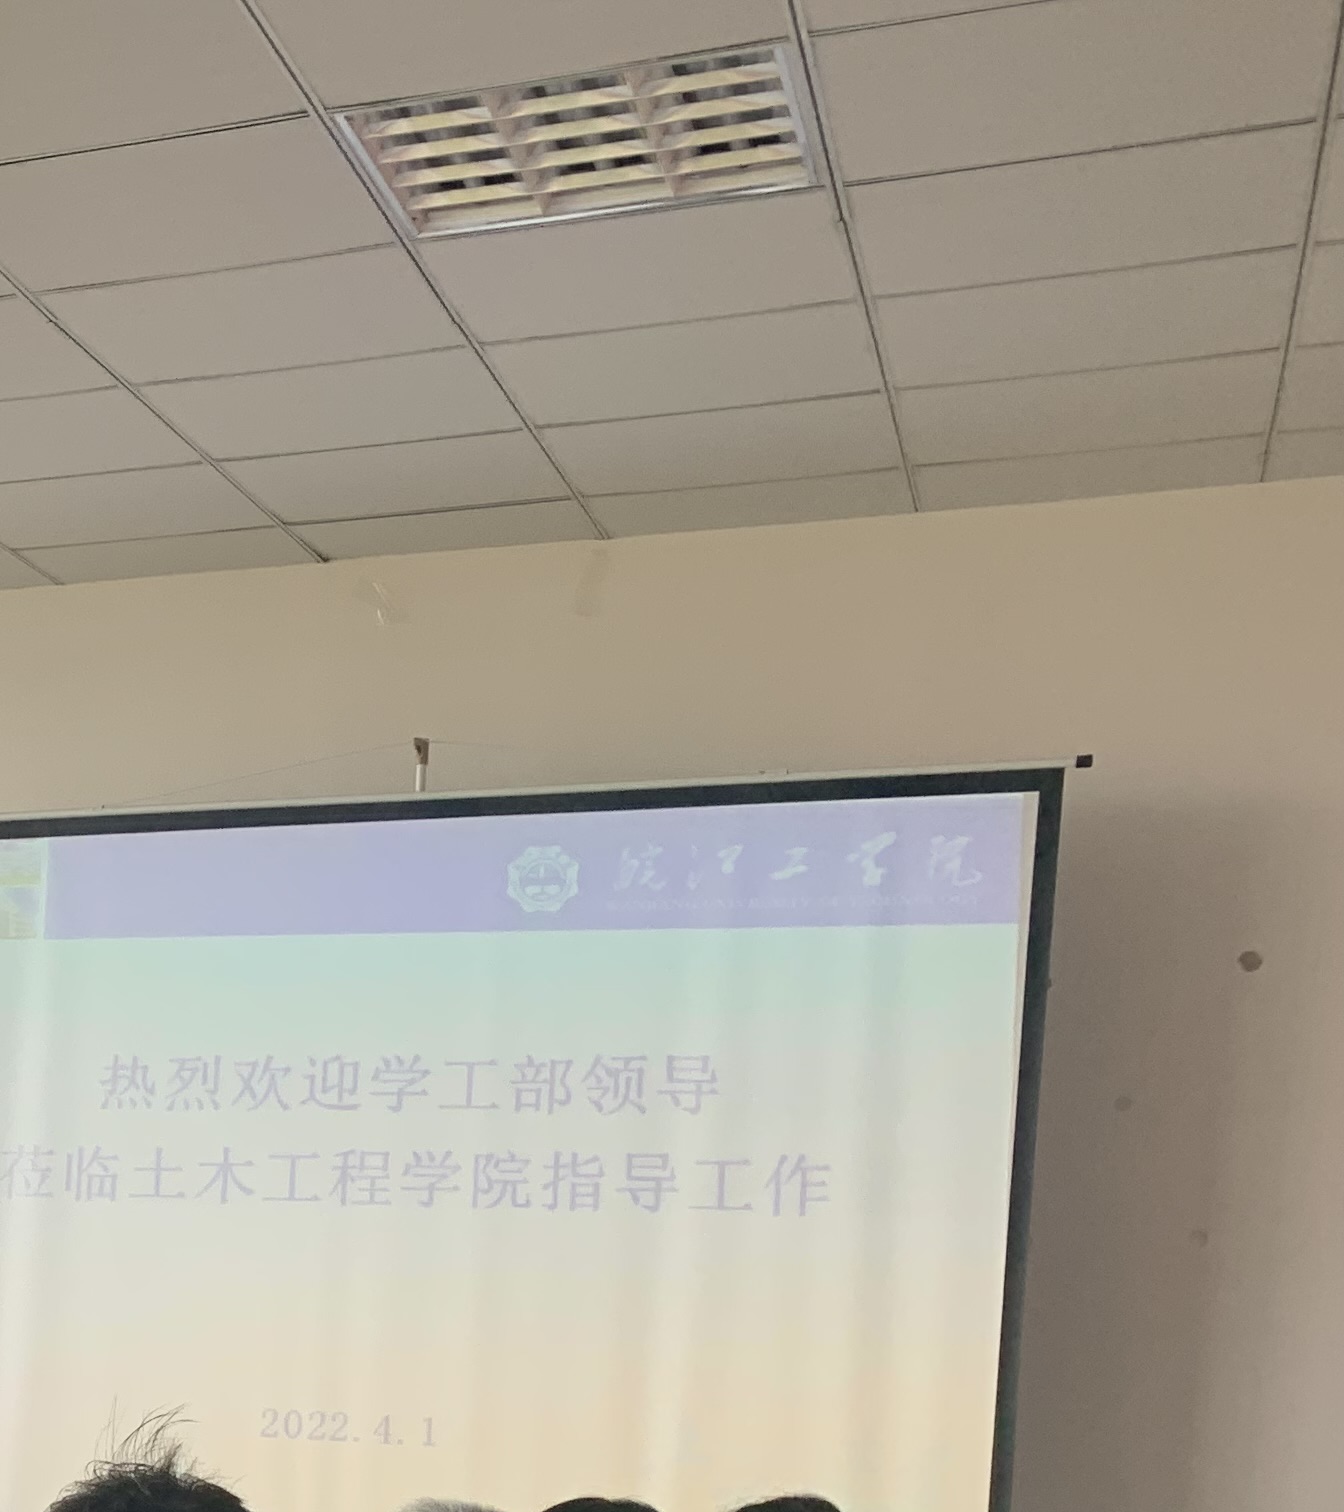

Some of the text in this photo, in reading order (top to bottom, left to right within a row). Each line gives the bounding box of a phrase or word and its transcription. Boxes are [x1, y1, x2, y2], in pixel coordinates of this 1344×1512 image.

[98, 1052, 720, 1116] 热烈欢迎学工部领导
[0, 1145, 833, 1218] 莅临土木工程学院指导工作
